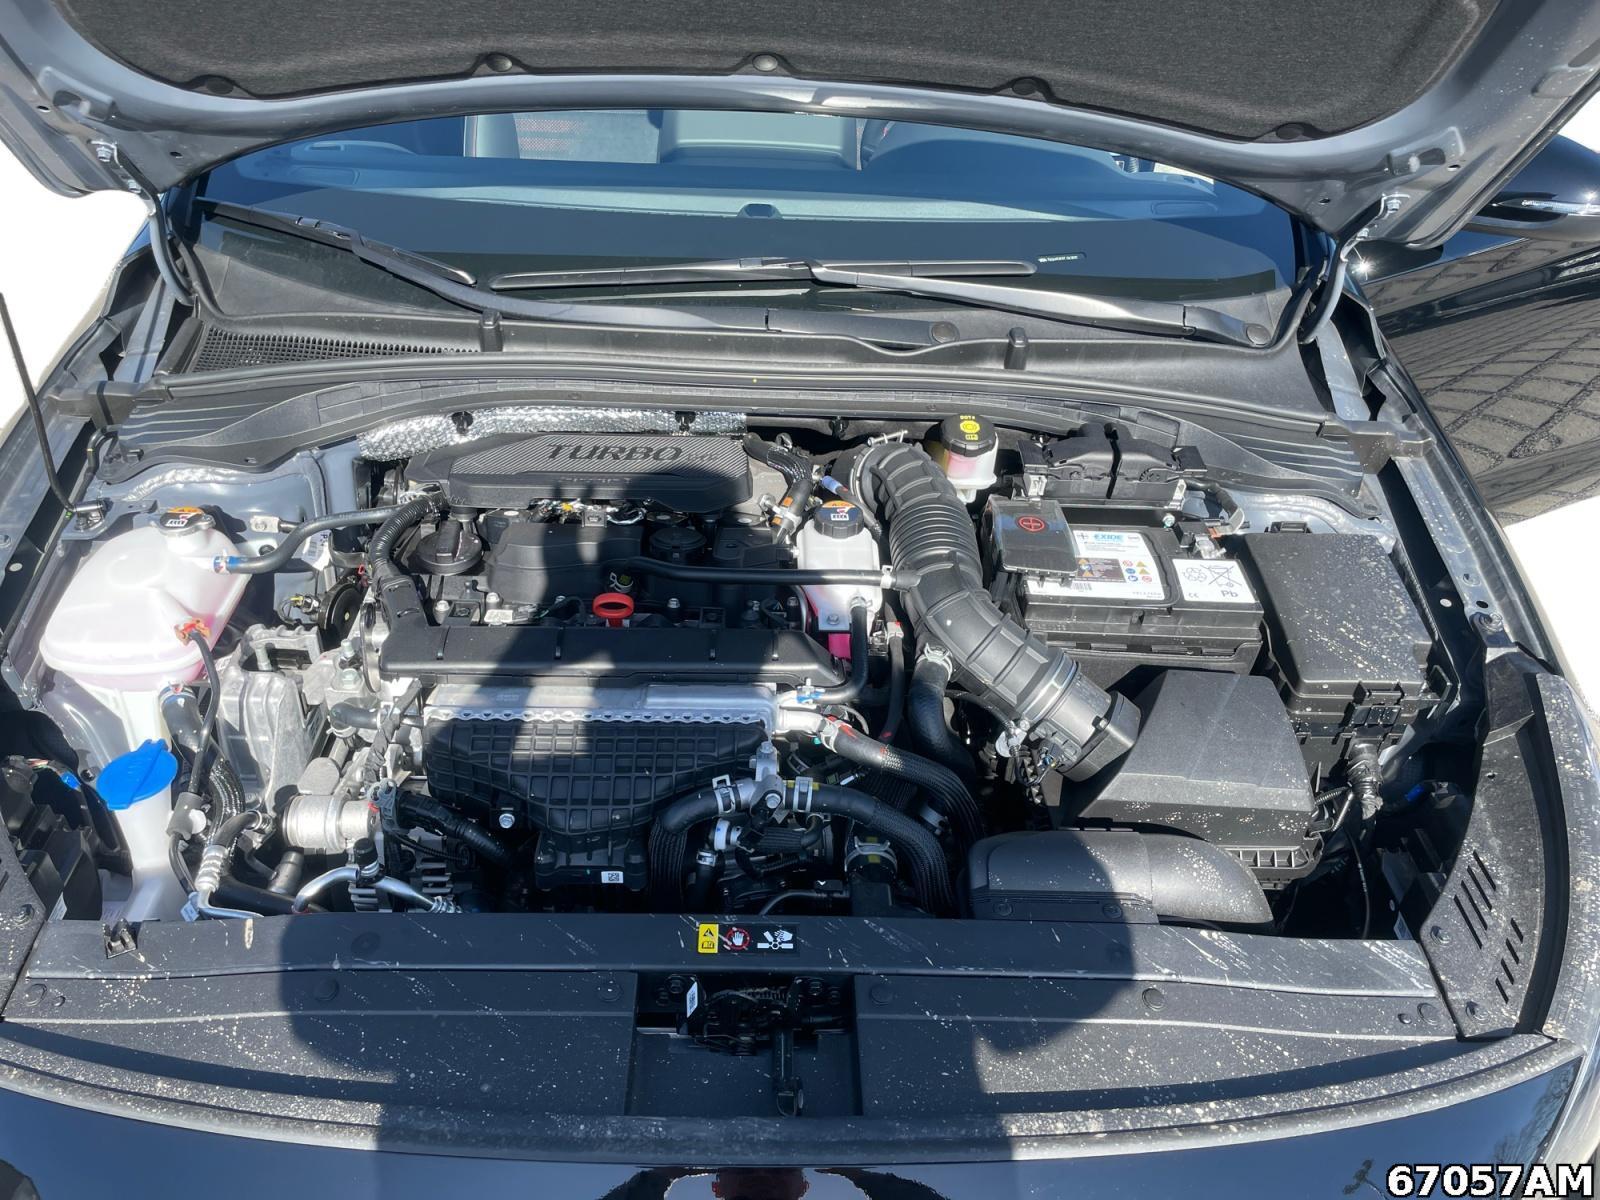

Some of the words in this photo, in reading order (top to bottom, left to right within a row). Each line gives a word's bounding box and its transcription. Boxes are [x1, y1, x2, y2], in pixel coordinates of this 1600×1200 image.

[547, 443, 683, 461] TURBO
[1093, 532, 1123, 541] EXIDE
[1220, 589, 1239, 598] Pb
